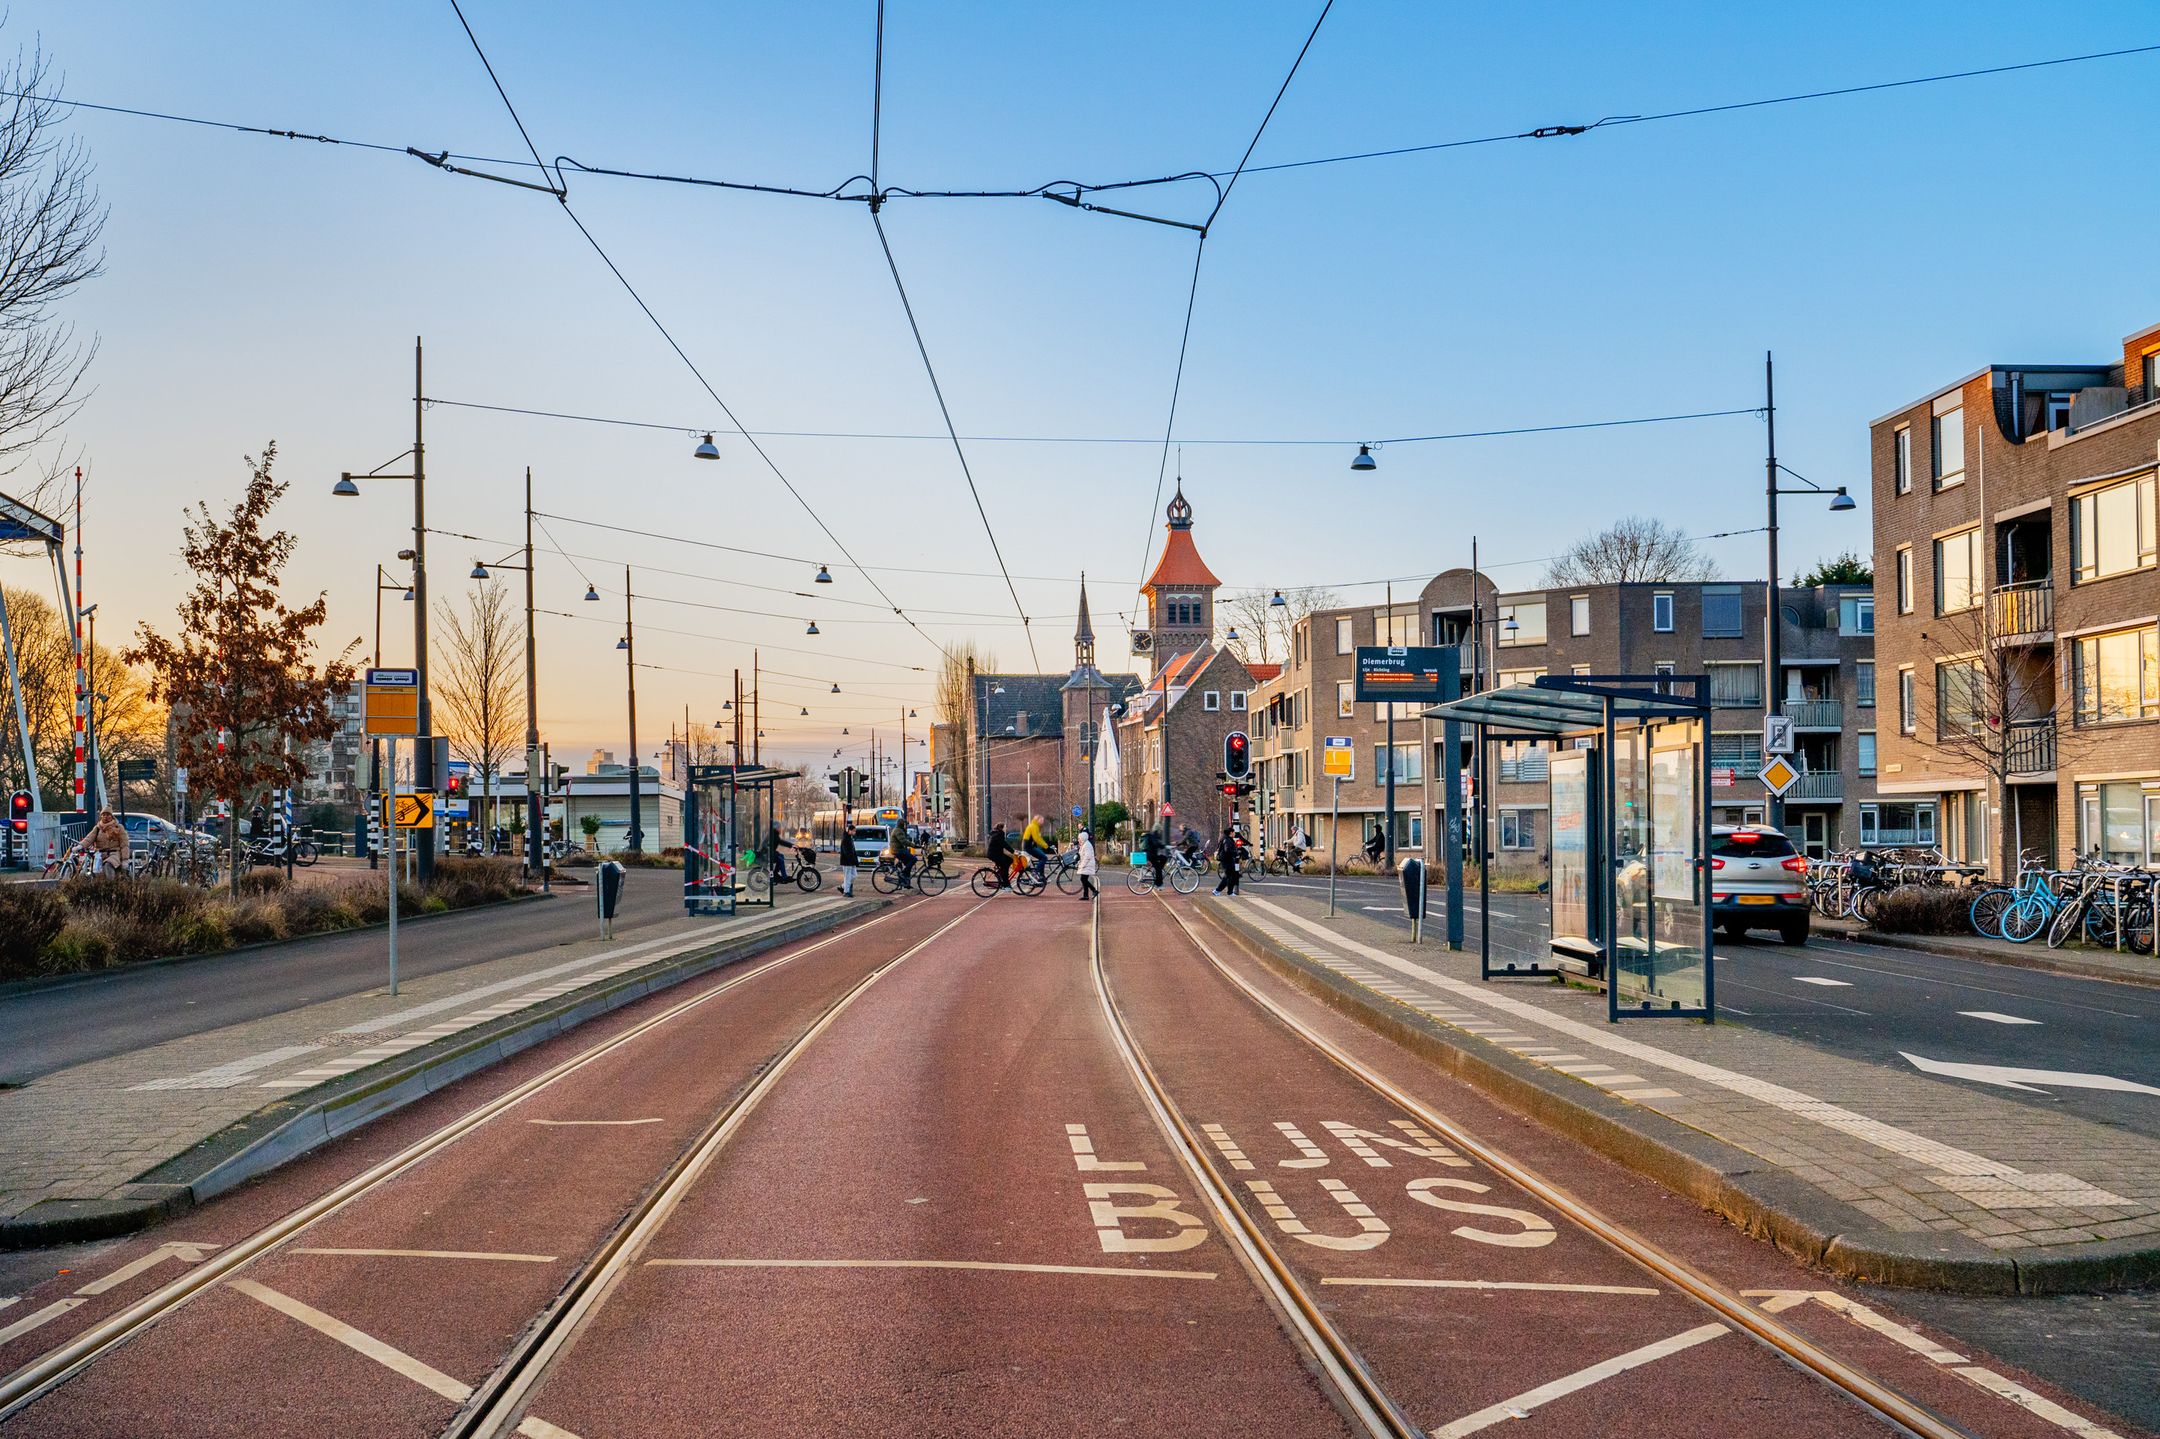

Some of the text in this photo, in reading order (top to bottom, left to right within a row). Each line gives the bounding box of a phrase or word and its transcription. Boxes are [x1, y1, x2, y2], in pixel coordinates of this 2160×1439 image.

[1362, 658, 1406, 667] Diemerbrug
[1065, 1119, 1475, 1171] LIJN
[1082, 1177, 1558, 1254] BUS
